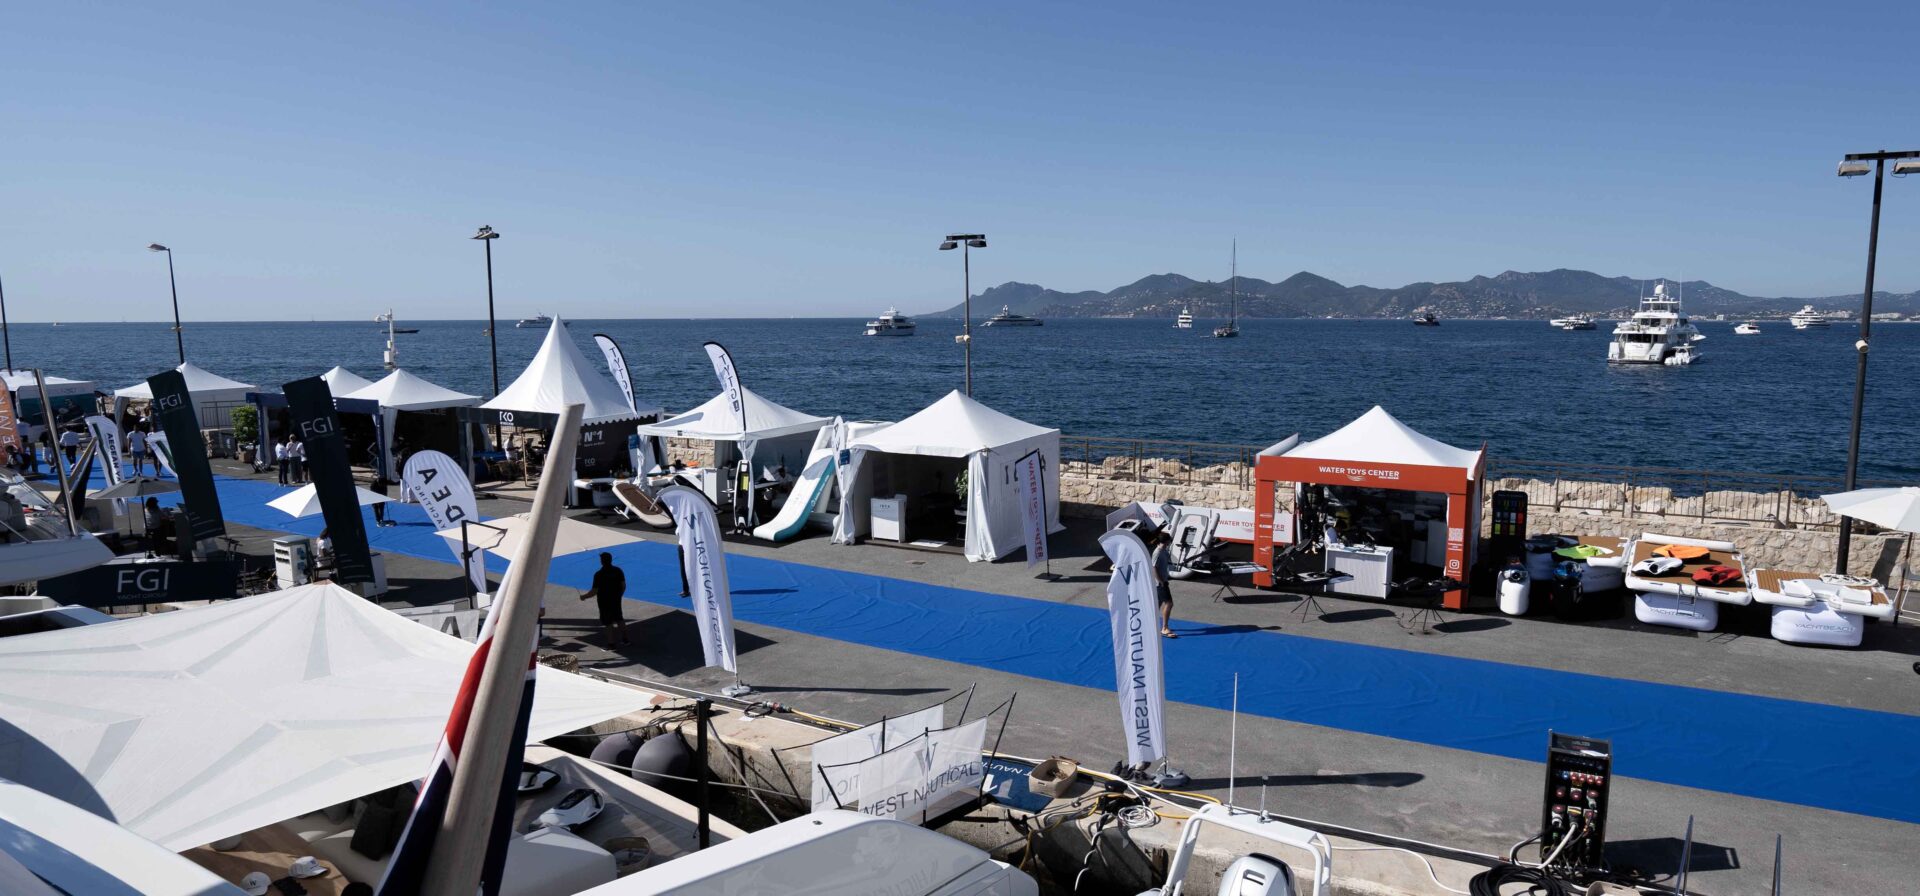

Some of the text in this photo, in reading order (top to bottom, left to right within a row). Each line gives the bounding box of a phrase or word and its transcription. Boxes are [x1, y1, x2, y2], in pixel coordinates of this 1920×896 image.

[159, 393, 182, 410] FGI
[301, 416, 333, 437] FGI
[106, 433, 120, 469] AEGEAN
[1029, 459, 1038, 494] WATER
[1319, 466, 1345, 474] WATER
[117, 568, 170, 593] FGI
[914, 761, 980, 805] NAUTICAL
